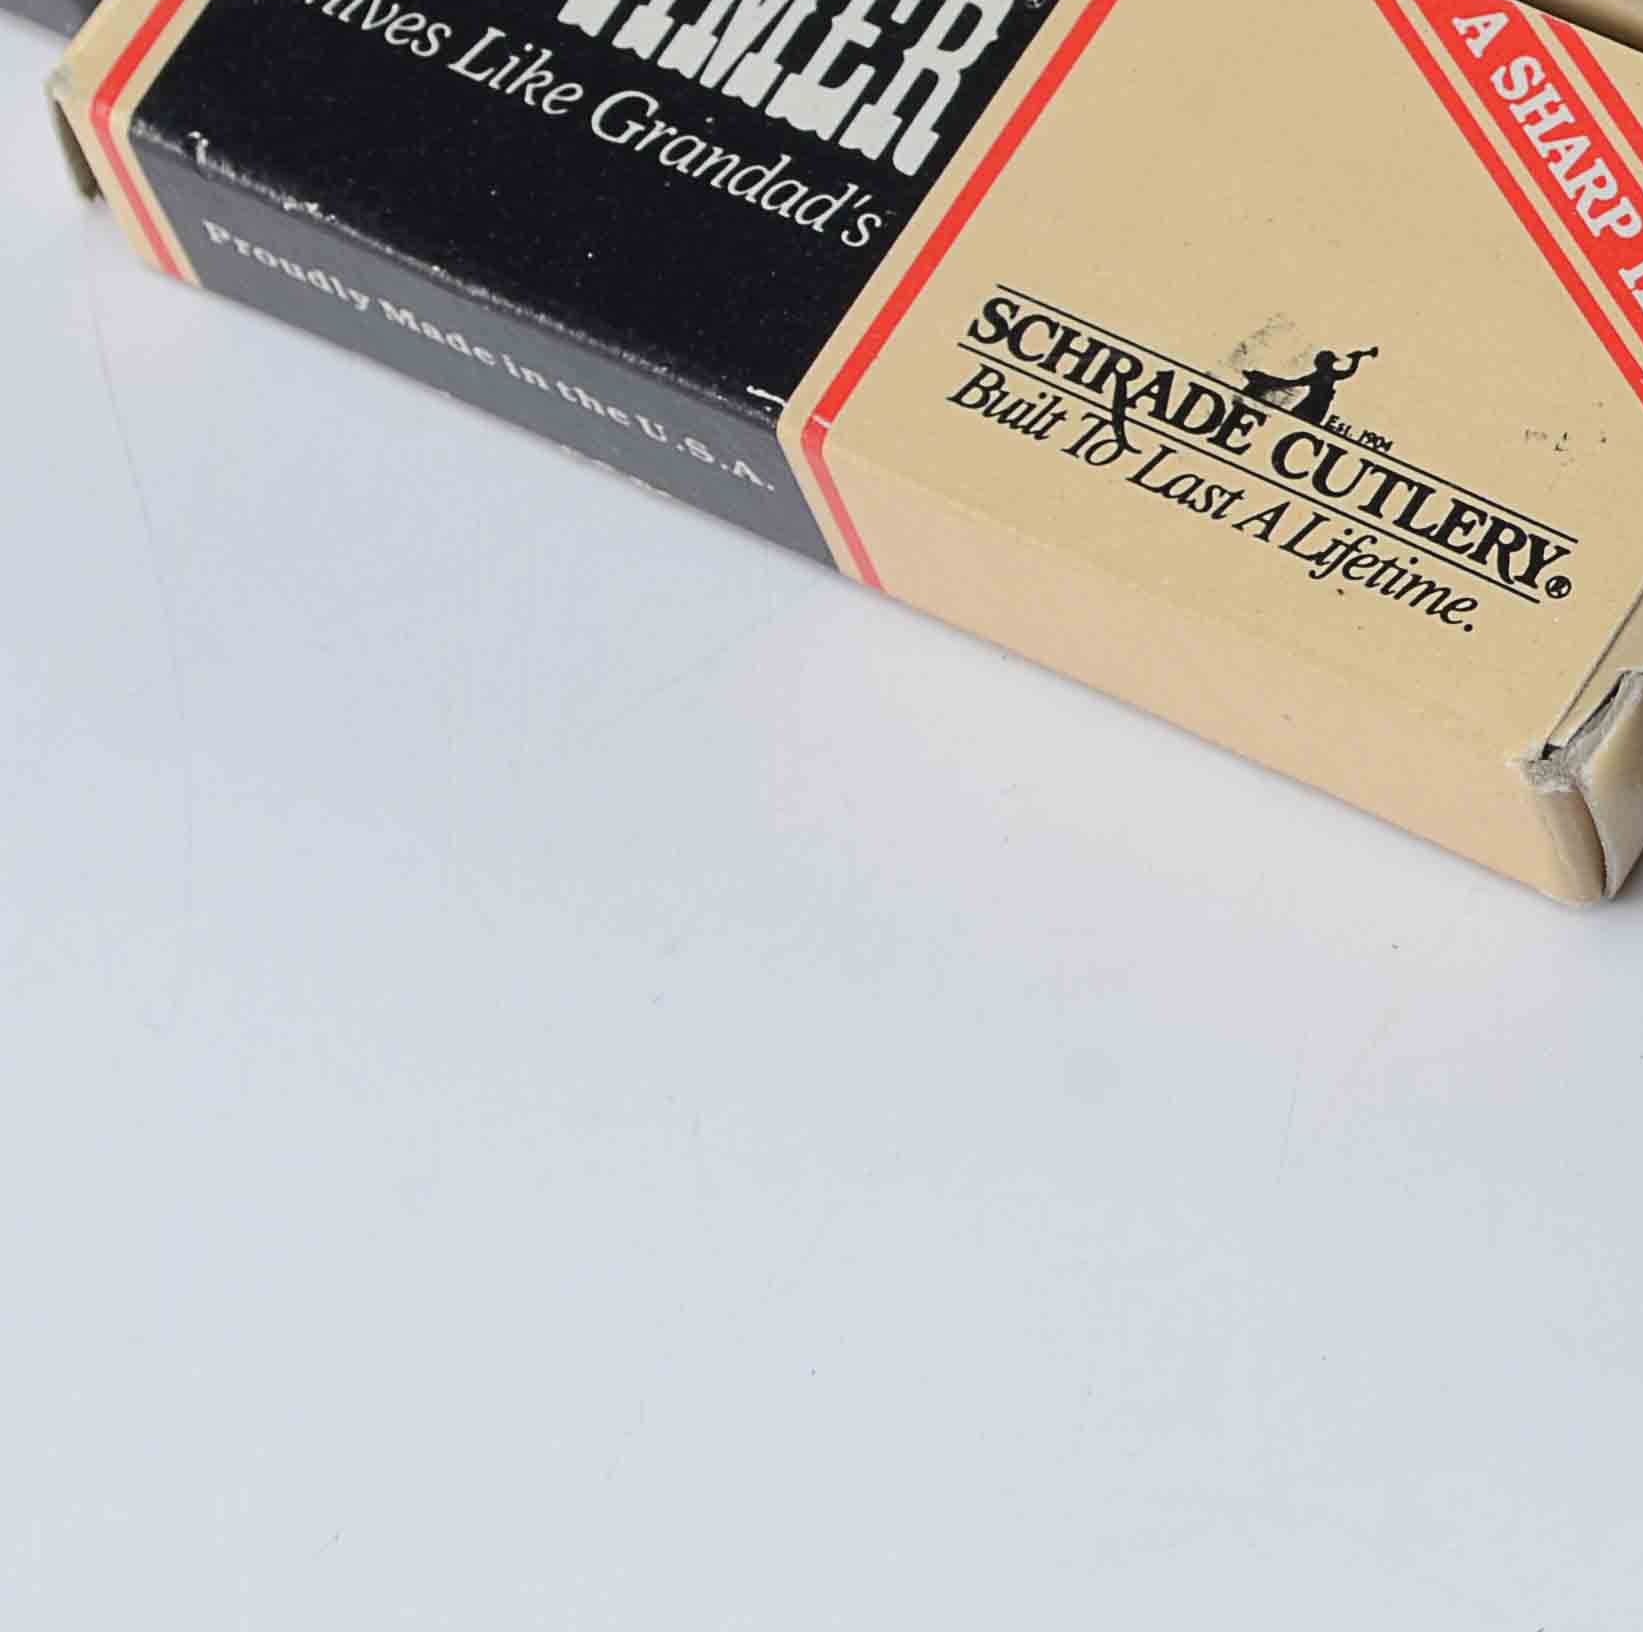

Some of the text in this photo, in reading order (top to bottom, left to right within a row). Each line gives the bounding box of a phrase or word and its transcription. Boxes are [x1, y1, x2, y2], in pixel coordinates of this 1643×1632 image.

[450, 28, 585, 116] Like
[591, 90, 883, 247] Grandad's
[1453, 8, 1508, 59] A
[1491, 55, 1642, 239] SHARP
[202, 220, 777, 492] Proudly Made in the U.S.A.
[969, 295, 1266, 455] SCHRADE
[946, 363, 1477, 633] Built To Last A Lifetime.
